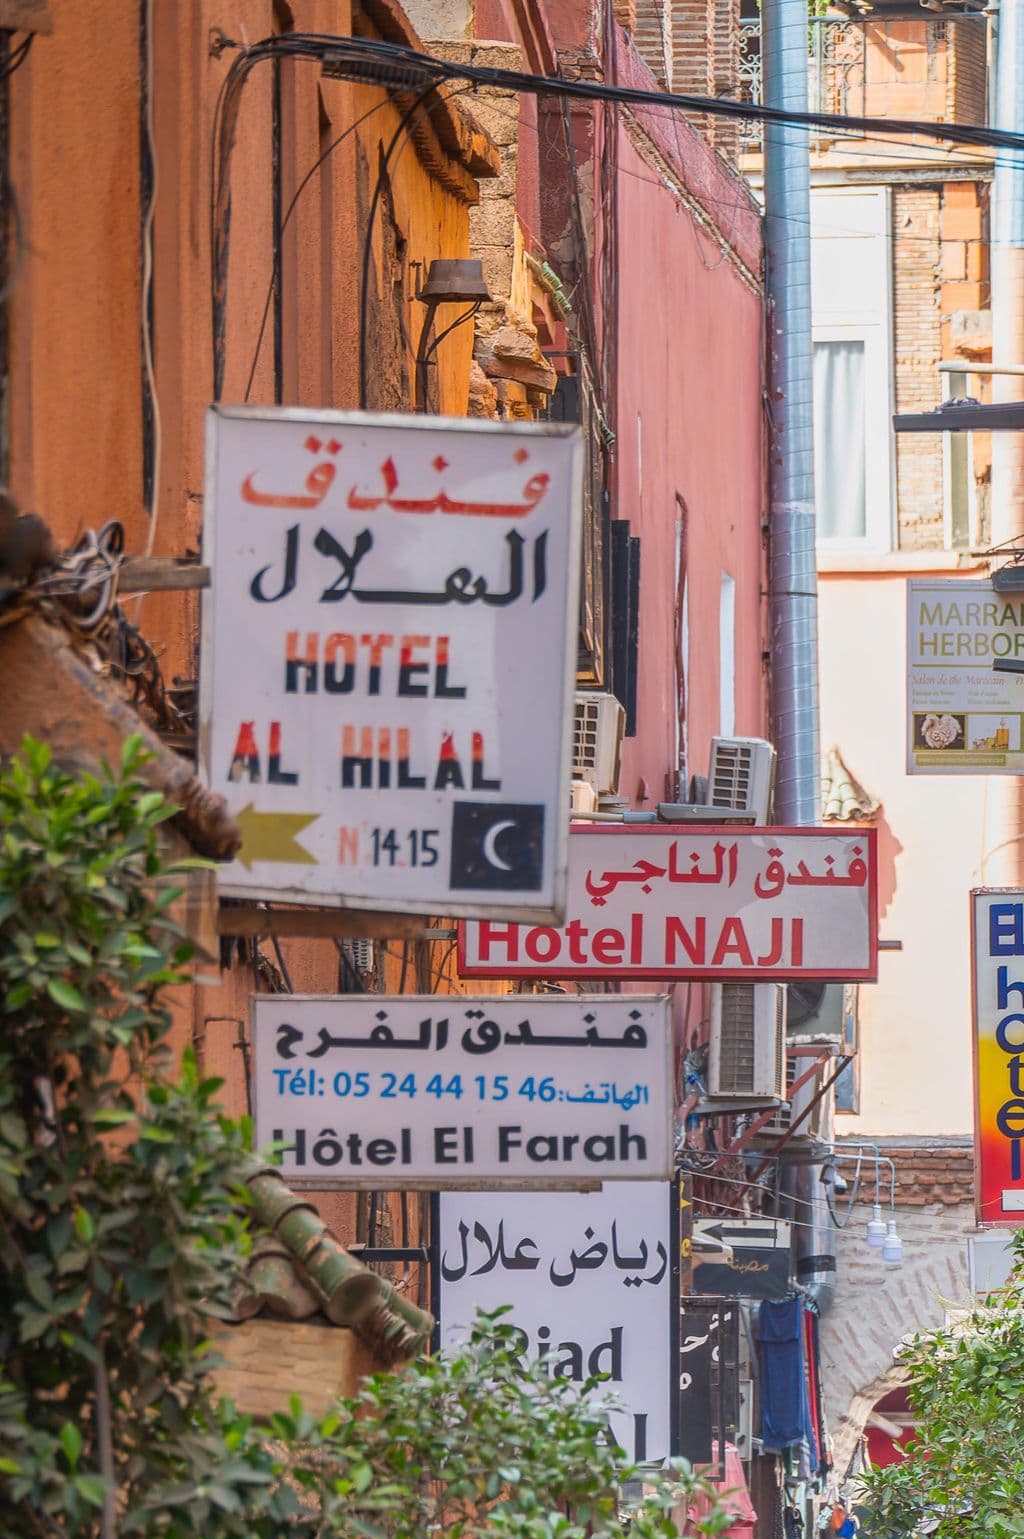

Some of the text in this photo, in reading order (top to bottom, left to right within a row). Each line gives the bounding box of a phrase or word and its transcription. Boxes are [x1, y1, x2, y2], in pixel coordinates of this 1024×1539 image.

[241, 435, 550, 518] فندق
[249, 522, 549, 607] الهلال
[284, 631, 467, 699] HOTEL
[227, 720, 502, 791] AL HILAL
[585, 840, 867, 907] فندق الناجي
[478, 913, 804, 967] Hotel NAJI
[275, 1009, 648, 1060] فندق الفرح
[272, 1068, 325, 1097] Tél:
[333, 1071, 370, 1098] 05
[380, 1072, 417, 1099] 24
[426, 1074, 464, 1100] 44
[474, 1075, 510, 1101] 15
[518, 1076, 557, 1103] 46
[273, 1124, 648, 1167] Hôtel El Farah
[441, 1218, 541, 1282] علال
[550, 1218, 668, 1287] رياض
